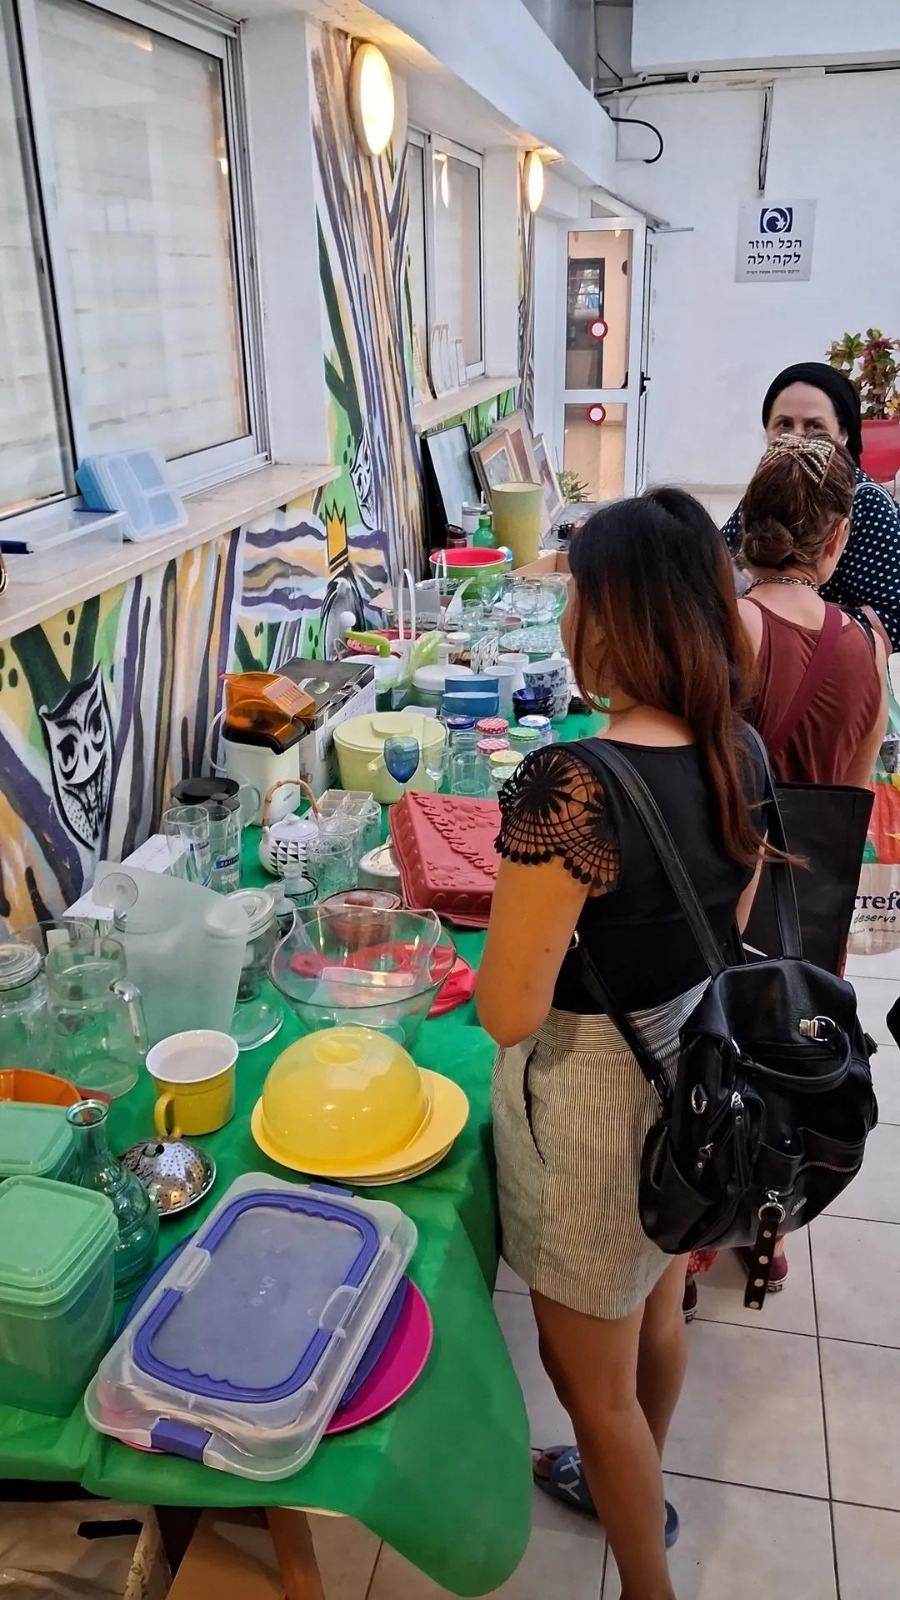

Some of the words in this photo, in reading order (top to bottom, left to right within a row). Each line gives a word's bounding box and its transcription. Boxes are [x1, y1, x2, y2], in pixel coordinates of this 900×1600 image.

[748, 240, 774, 250] חוזר
[778, 238, 802, 249] הכל
[747, 252, 801, 267] לקהילה
